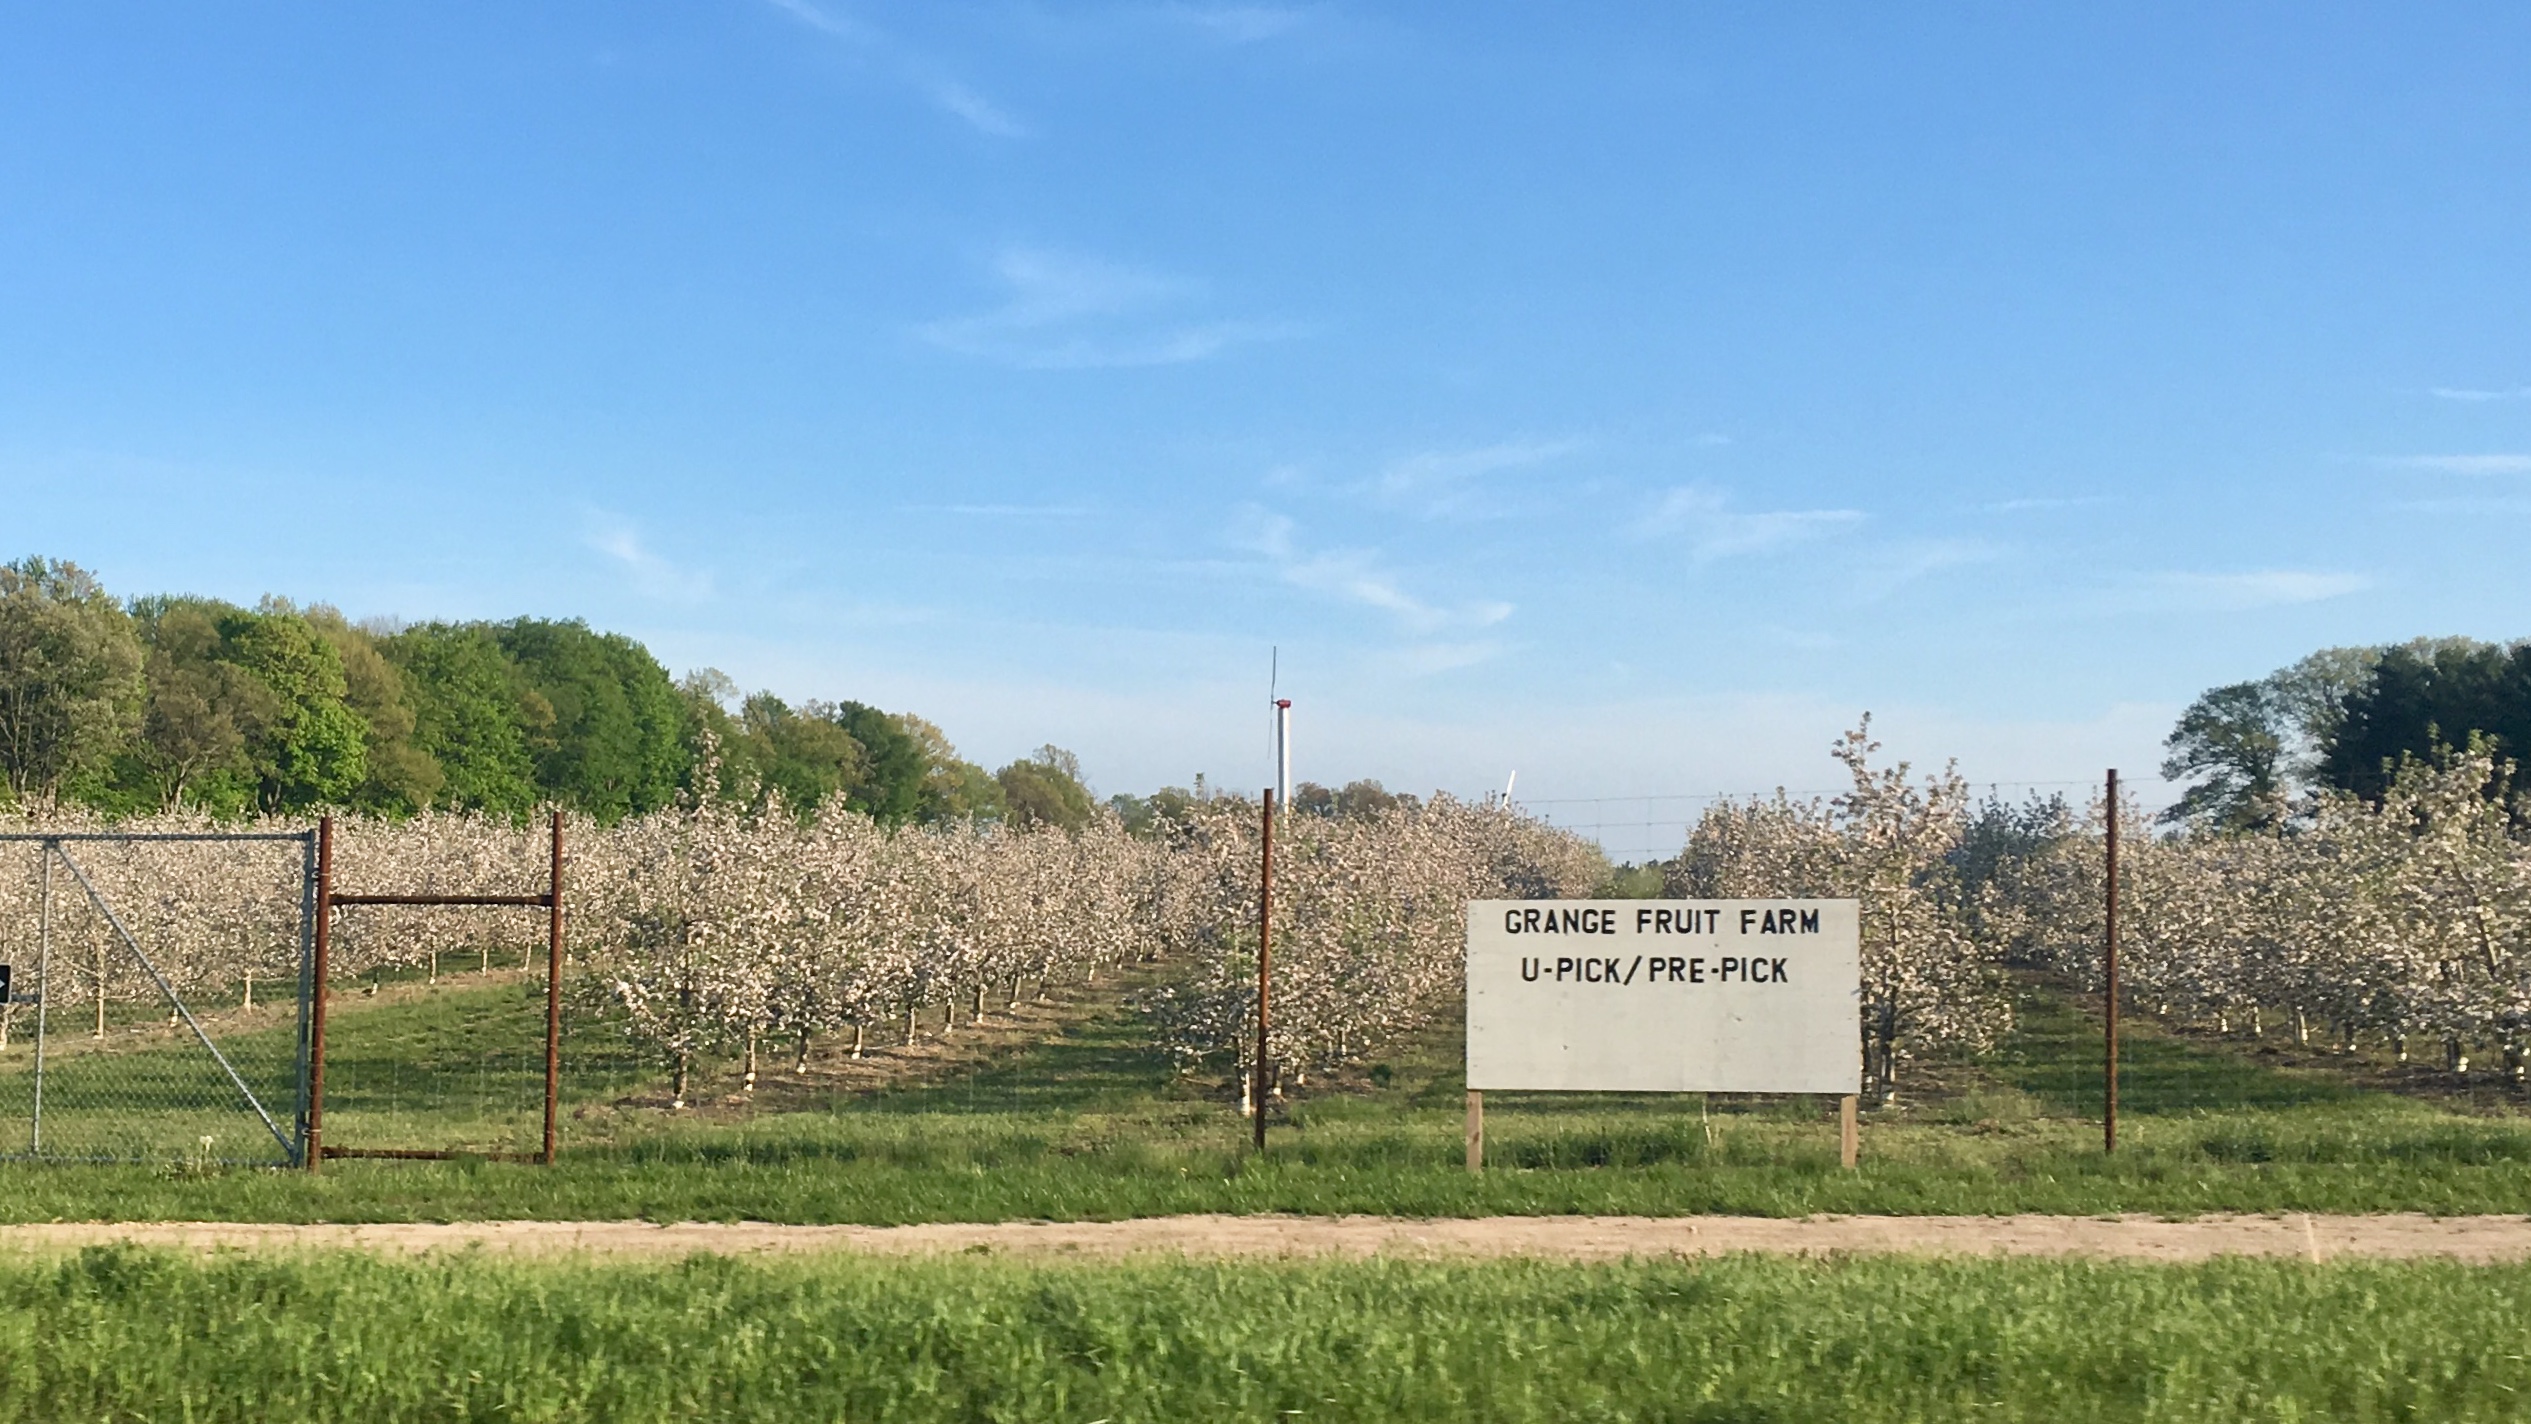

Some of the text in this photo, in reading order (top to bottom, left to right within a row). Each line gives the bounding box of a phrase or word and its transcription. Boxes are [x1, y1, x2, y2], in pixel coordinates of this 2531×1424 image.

[1505, 908, 1820, 935] GRANGE FRUIT FARM
[1521, 956, 1788, 986] U-PICK/PRE-PICK
